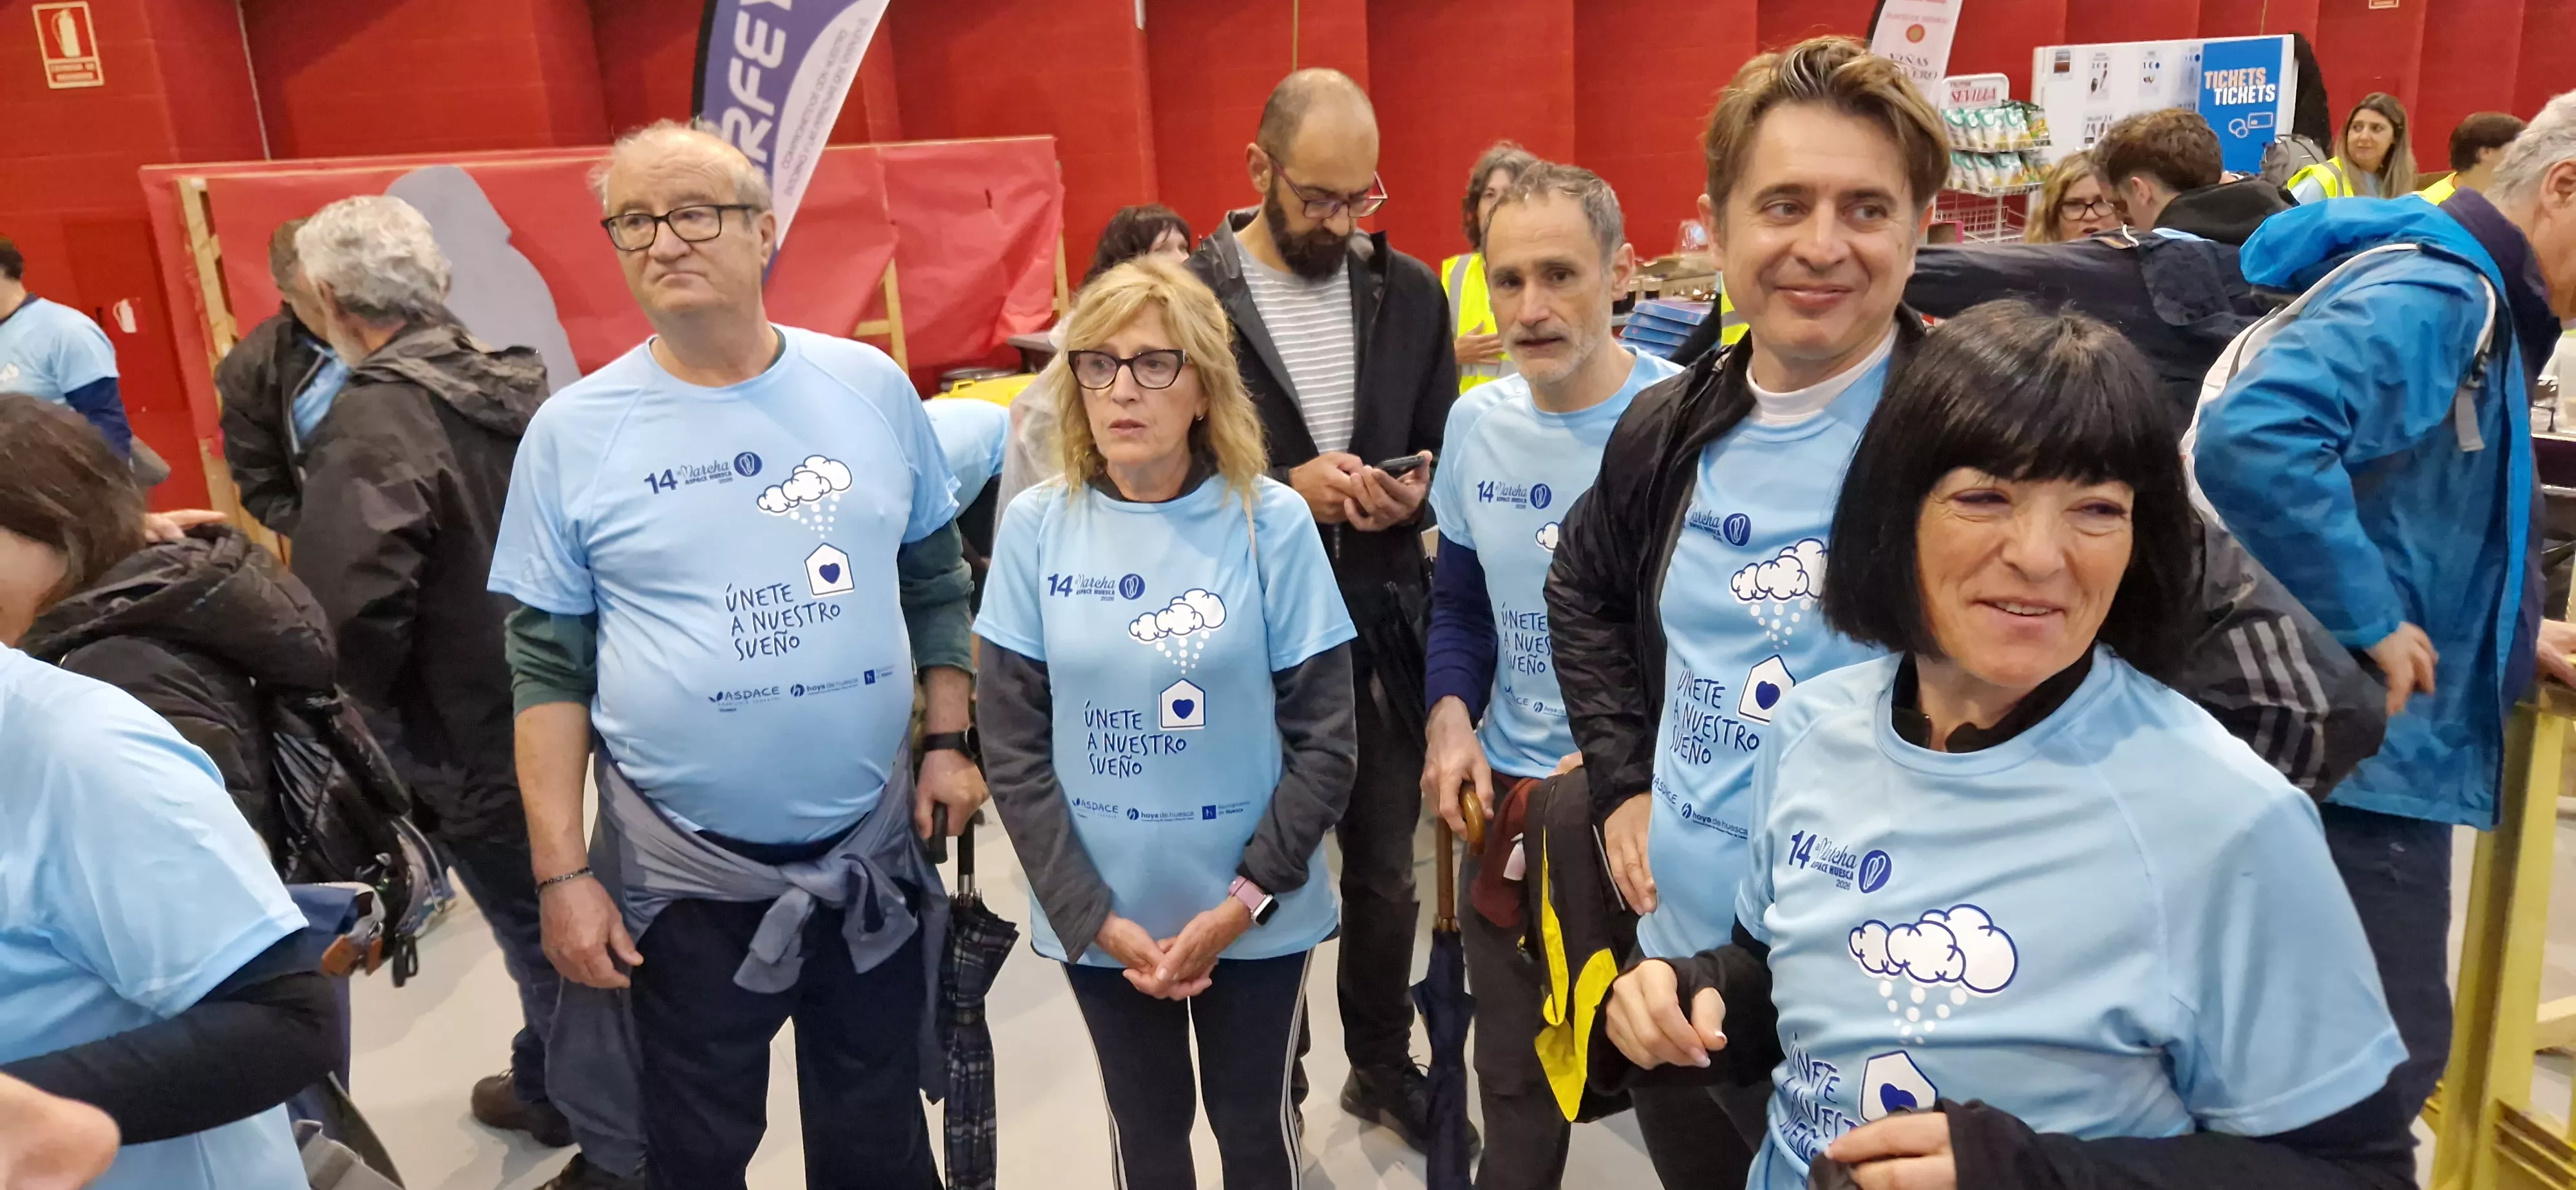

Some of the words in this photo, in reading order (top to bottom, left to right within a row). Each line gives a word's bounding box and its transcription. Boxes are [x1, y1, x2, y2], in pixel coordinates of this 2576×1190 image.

[2204, 67, 2266, 90] TICKETS
[2214, 84, 2276, 106] TICKETS
[725, 582, 794, 613] ÚNETE
[731, 615, 744, 637] A
[752, 601, 841, 634] NUESTRO
[1501, 601, 1547, 632] ÚNETE
[734, 628, 800, 662] SUEÑO
[1504, 630, 1510, 647] A
[1515, 632, 1551, 657] NUES
[1677, 657, 1726, 710] ÚNETE
[1084, 699, 1143, 730] ÚNETE
[1674, 697, 1680, 721] A
[1682, 702, 1760, 752] NUESTRO
[1088, 731, 1097, 751] A
[1104, 732, 1187, 756] NUESTRO
[1669, 724, 1712, 766] SUEÑO
[1088, 753, 1142, 779] SUEÑO
[1692, 810, 1712, 823] hoya
[1721, 820, 1748, 836] huesca
[1829, 865, 1854, 881] HUESCA
